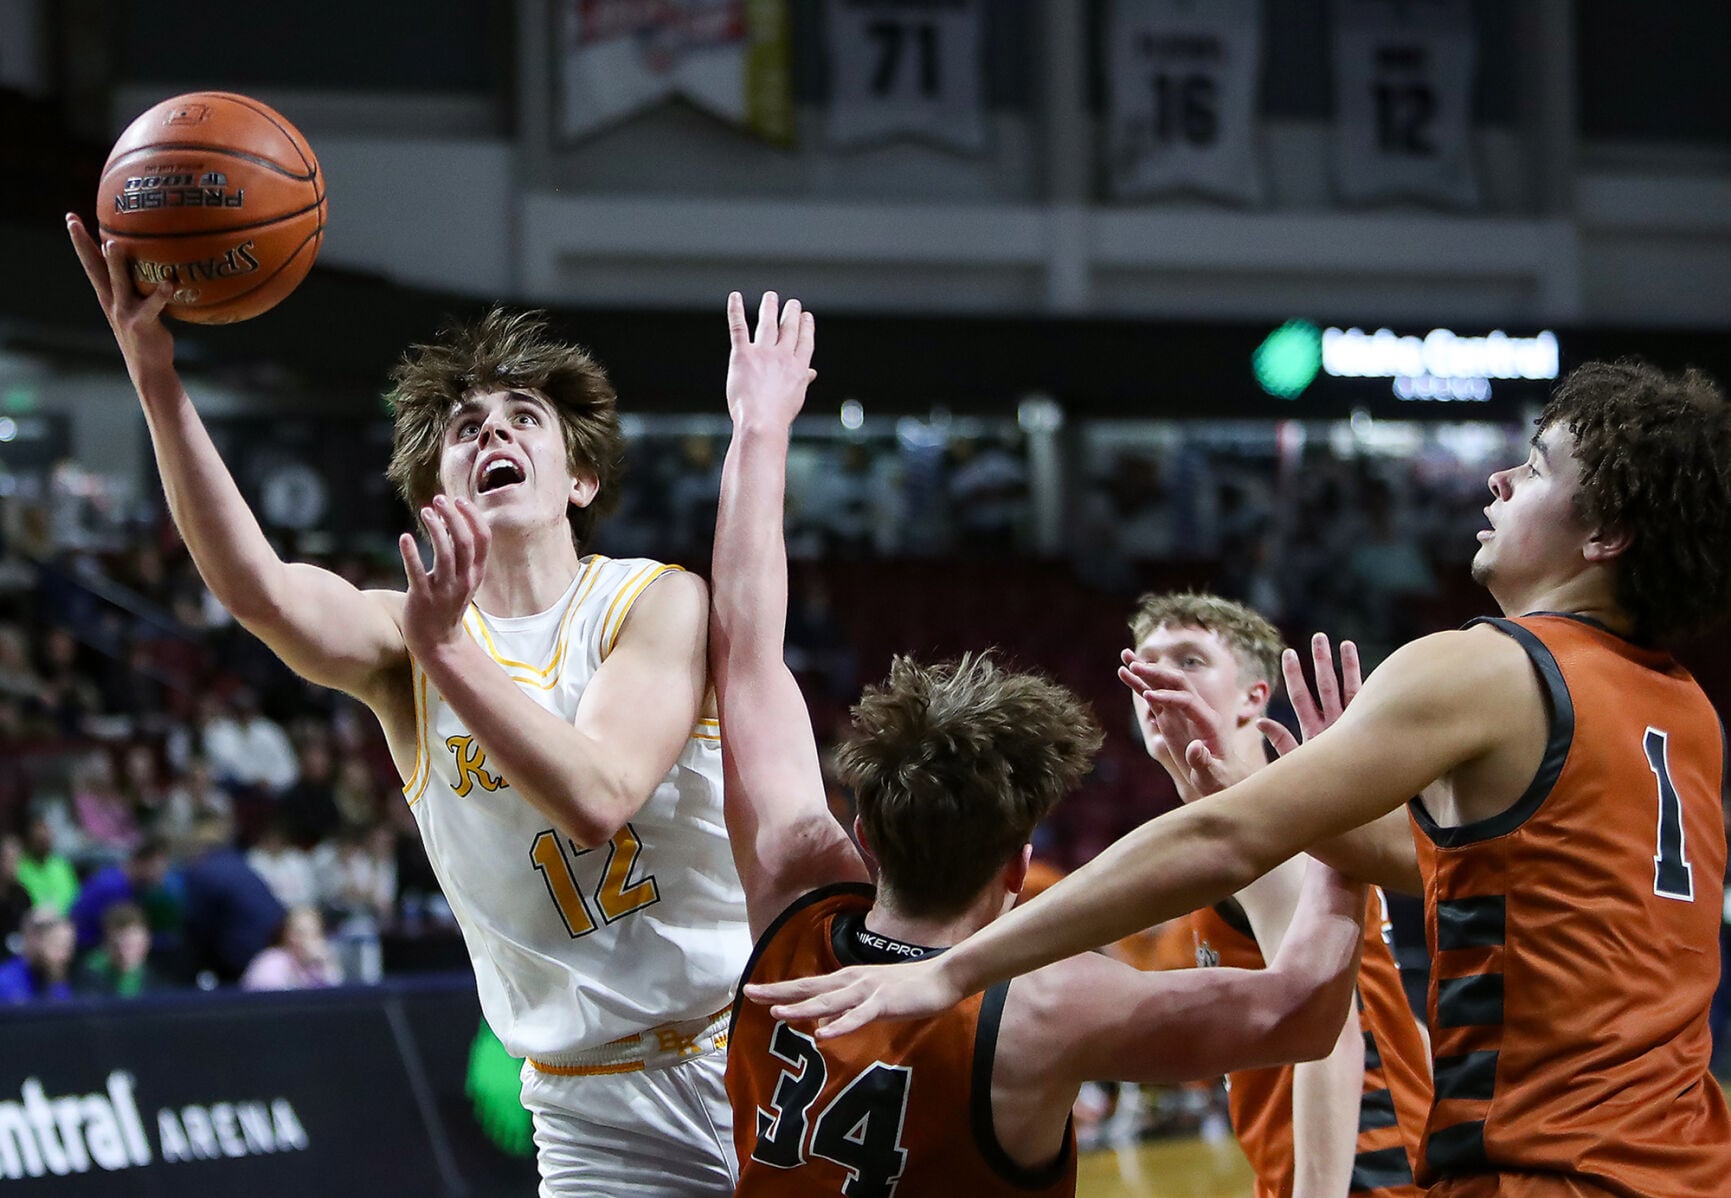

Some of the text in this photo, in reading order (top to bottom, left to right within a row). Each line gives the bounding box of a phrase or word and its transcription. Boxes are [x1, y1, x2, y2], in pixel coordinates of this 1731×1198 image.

[867, 20, 940, 96] 71
[1152, 73, 1219, 149] 16
[1373, 81, 1438, 157] 12
[114, 187, 245, 215] PRECISION
[132, 239, 261, 284] SPALDIN
[1642, 725, 1695, 903] 1
[529, 822, 661, 939] 12
[856, 931, 925, 958] NIKE PRO
[0, 1068, 310, 1180] ntral ARENA
[750, 1019, 913, 1198] 34
